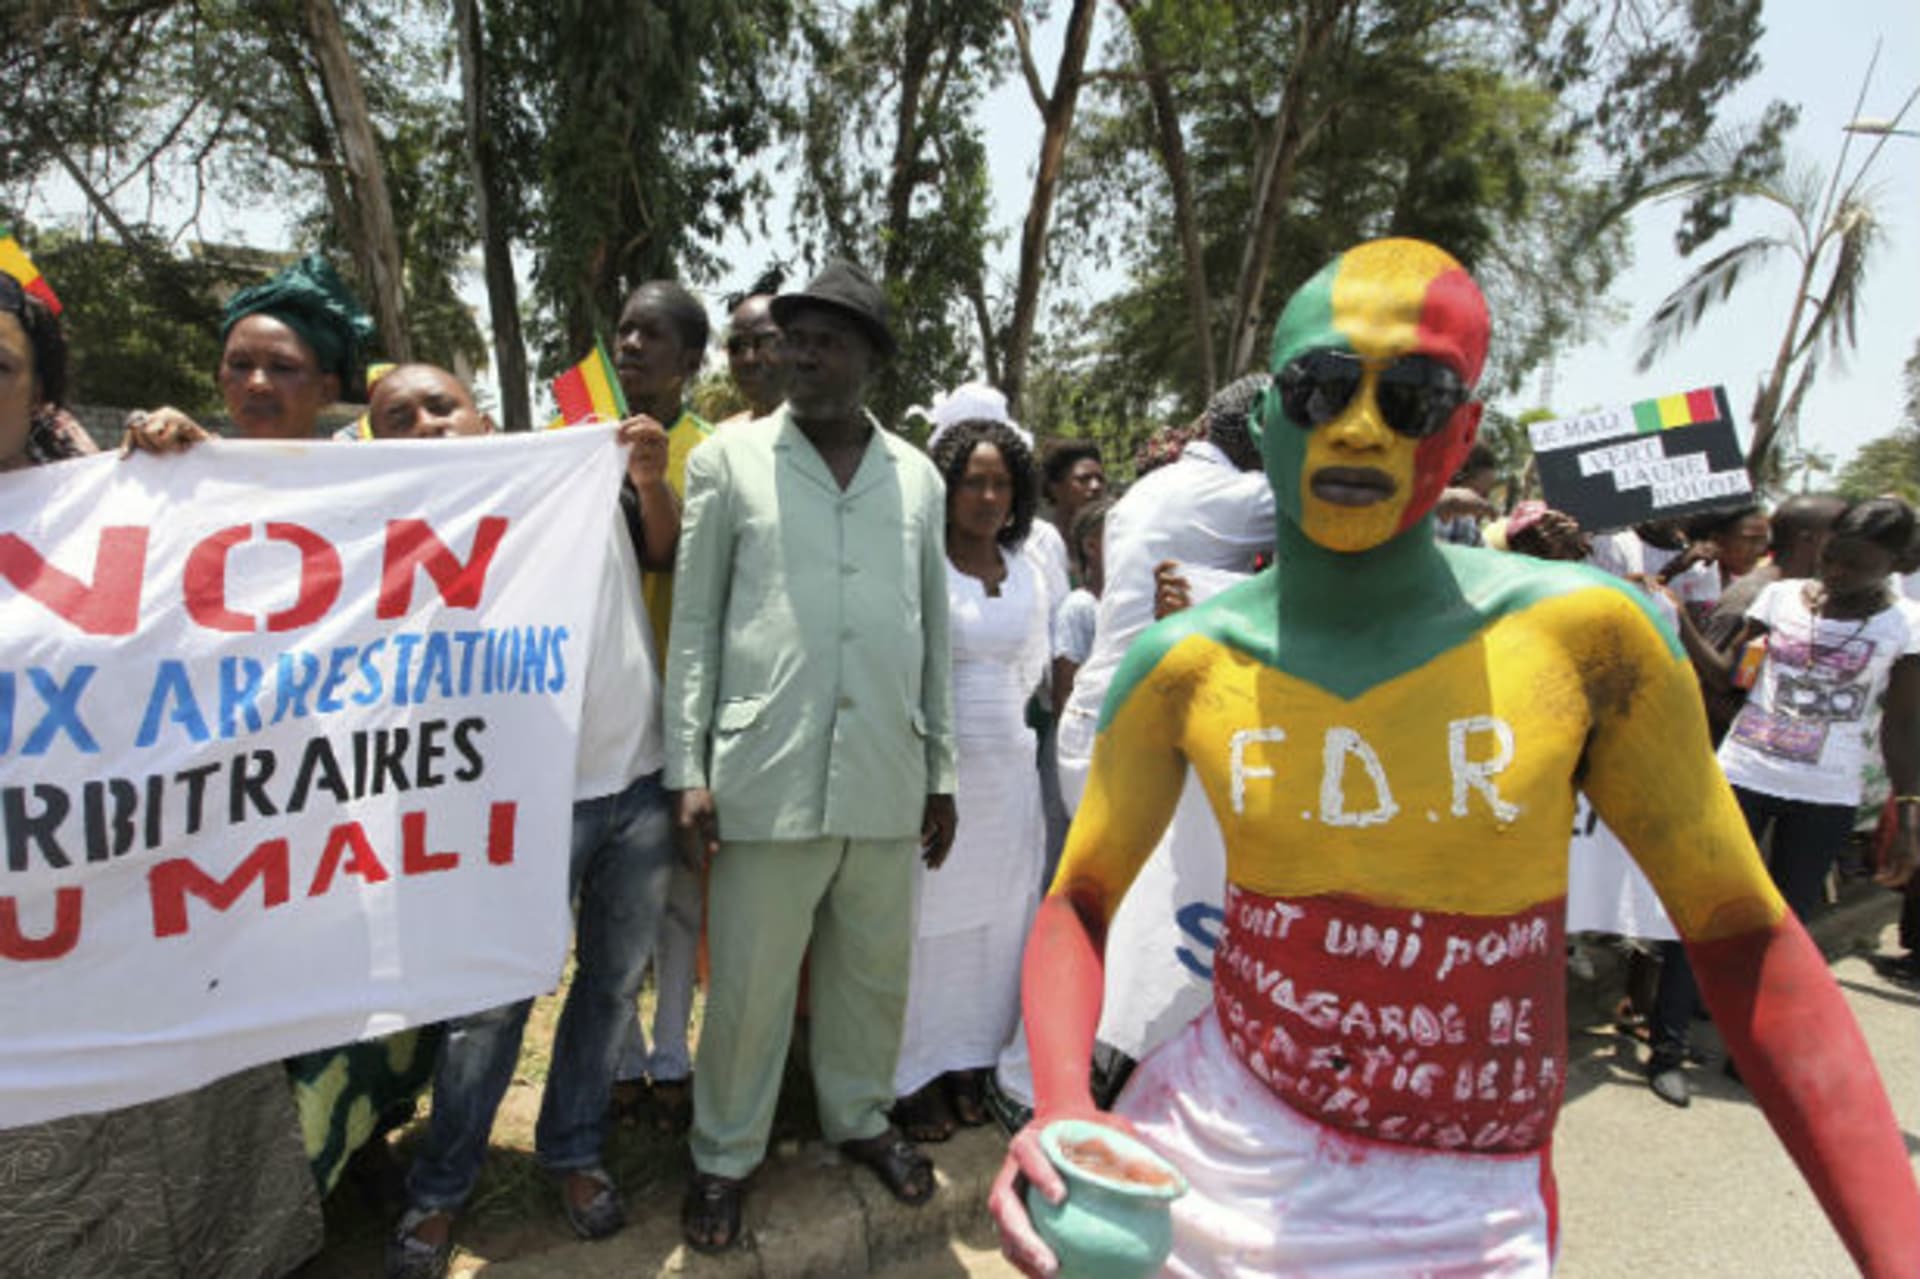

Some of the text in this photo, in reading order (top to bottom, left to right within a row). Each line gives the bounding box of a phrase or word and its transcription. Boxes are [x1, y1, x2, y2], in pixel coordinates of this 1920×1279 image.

[1588, 440, 1656, 468] VERT
[1620, 456, 1703, 484] JAUNE
[1654, 472, 1746, 504] ROUGE
[0, 516, 508, 636] NON
[135, 625, 569, 748] ARRESTATIONS
[149, 802, 517, 938] MALI
